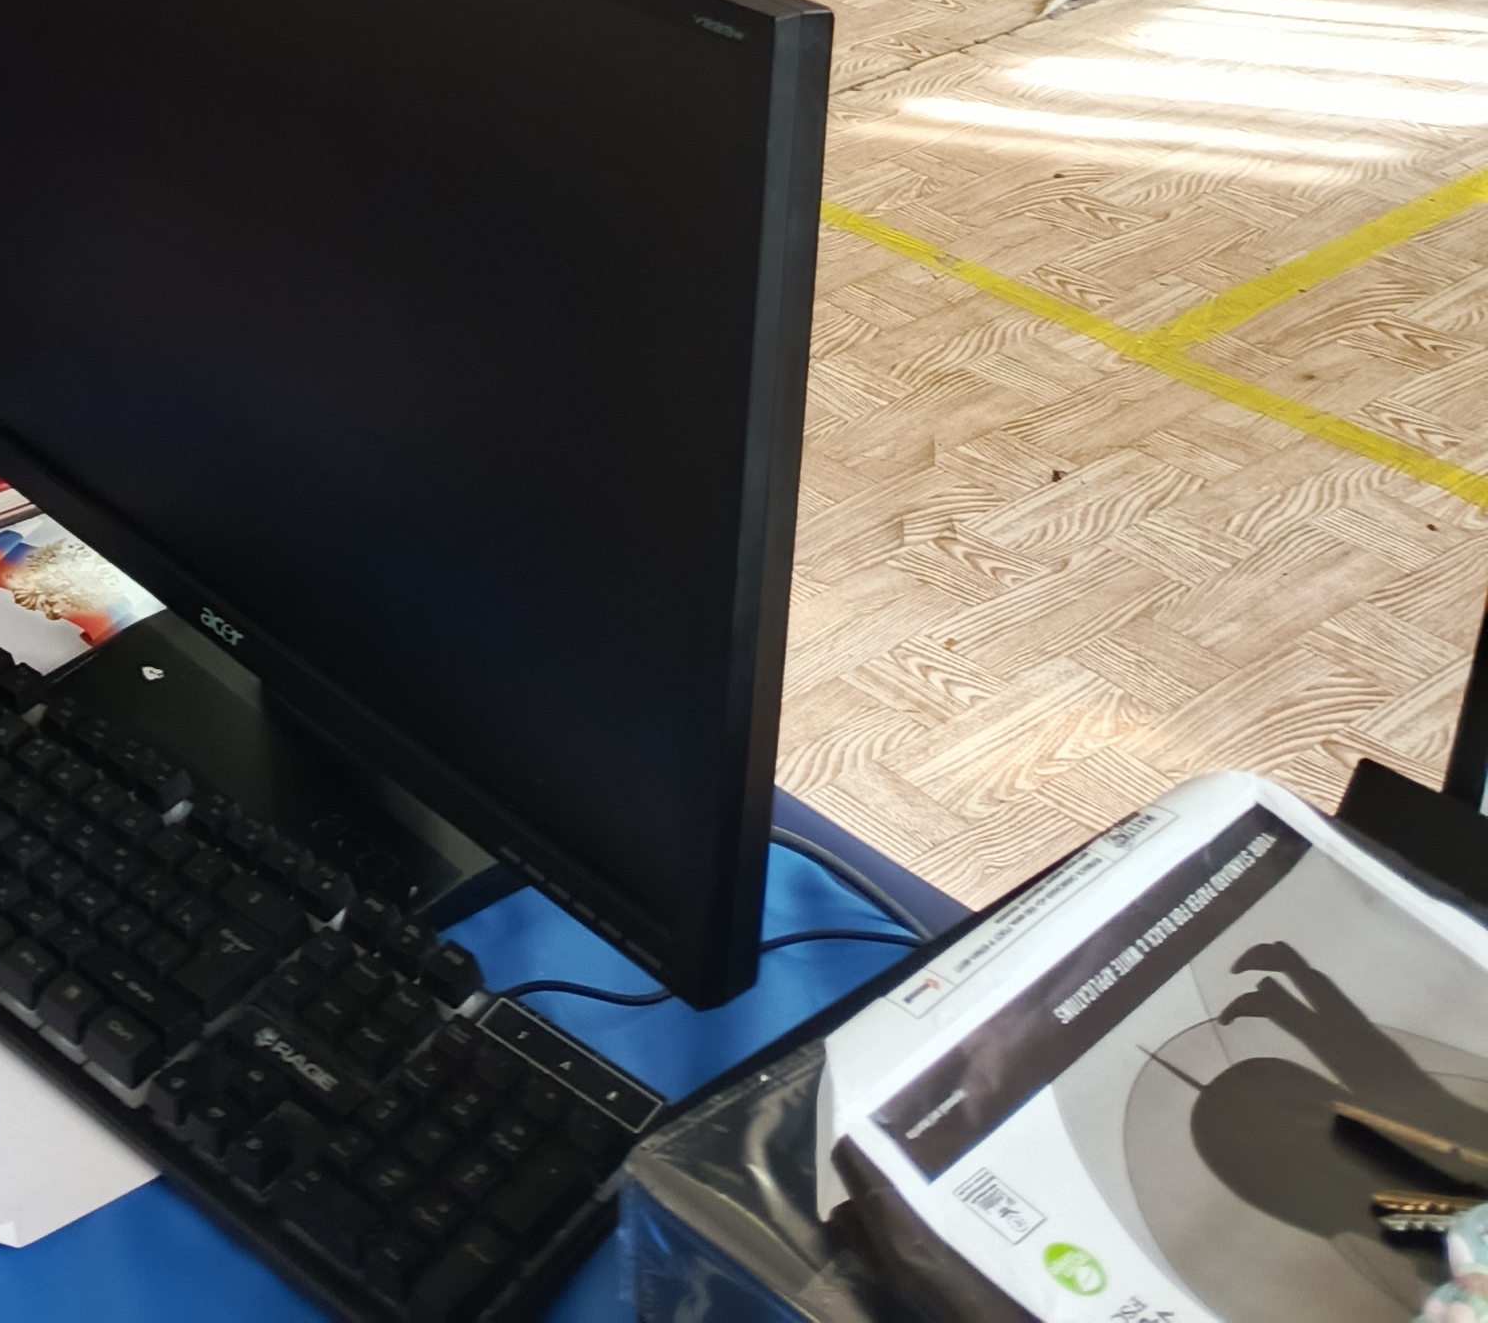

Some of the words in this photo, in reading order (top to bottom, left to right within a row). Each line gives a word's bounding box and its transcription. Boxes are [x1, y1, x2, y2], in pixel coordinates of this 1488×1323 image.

[200, 607, 243, 645] acer
[1209, 851, 1257, 891] STANDARD
[1184, 884, 1218, 911] PAPER
[1168, 906, 1193, 925] FOR
[1143, 919, 1177, 947] BLACK
[1109, 947, 1145, 974] WHITE
[1052, 967, 1119, 1023] APPLICATIONS
[269, 1039, 340, 1093] RAGE
